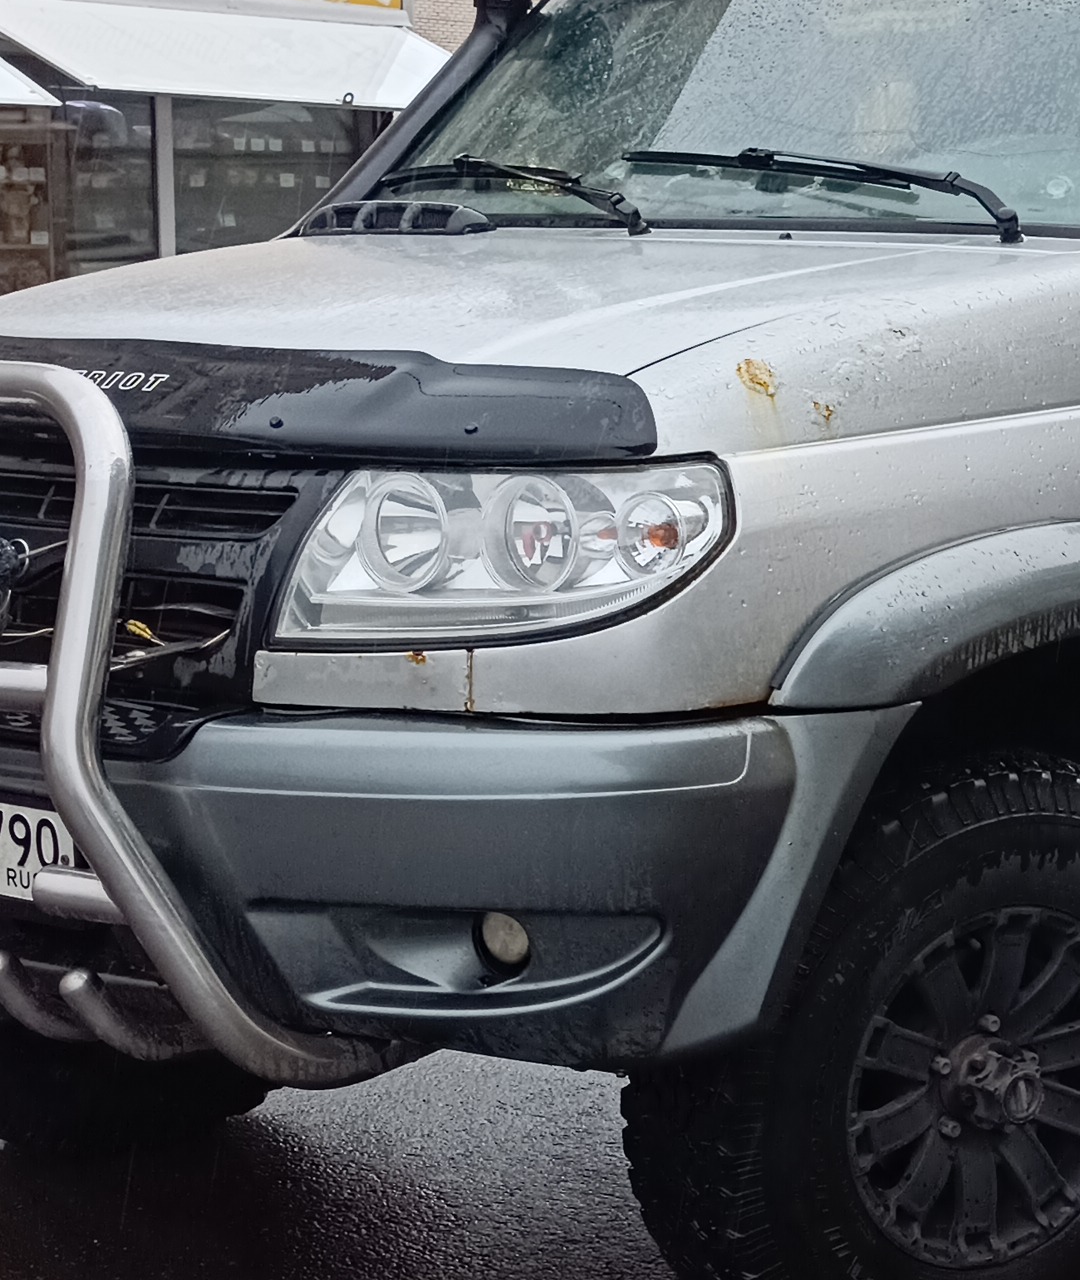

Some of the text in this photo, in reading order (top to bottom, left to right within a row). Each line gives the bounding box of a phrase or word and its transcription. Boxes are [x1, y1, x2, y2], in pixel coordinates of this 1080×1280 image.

[74, 370, 170, 391] RIOT
[0, 810, 60, 867] 90
[7, 867, 38, 889] RU
